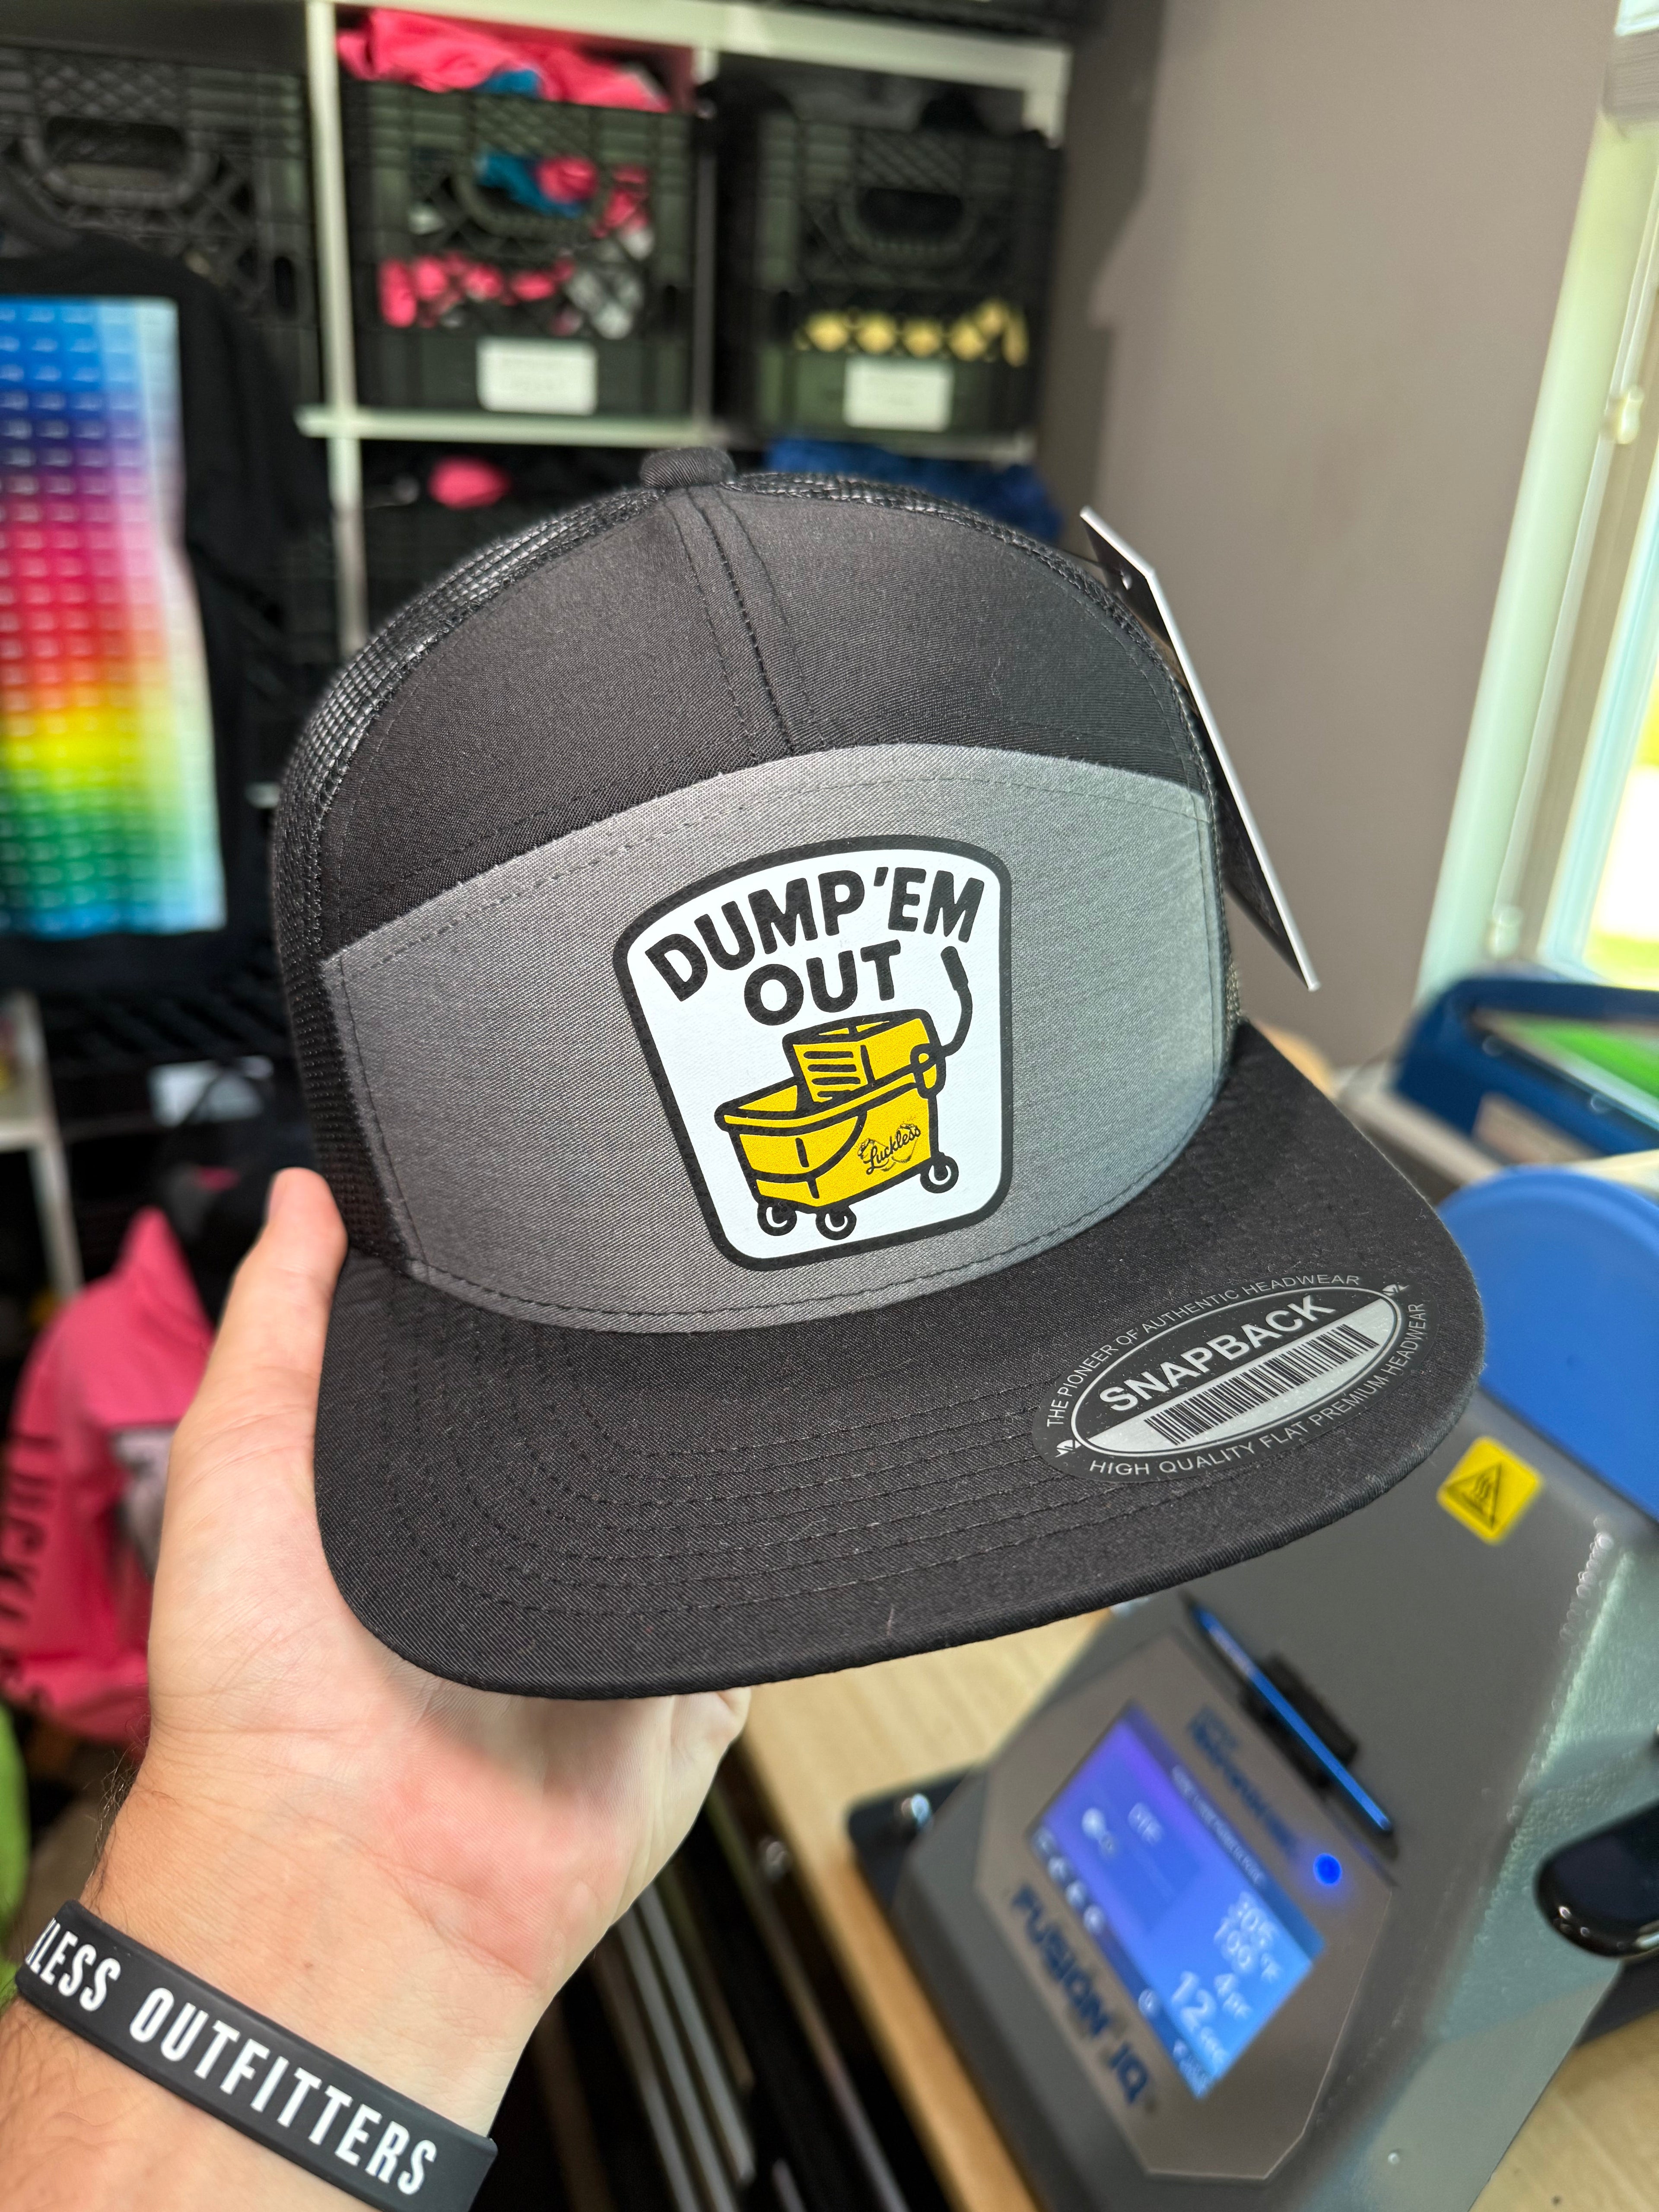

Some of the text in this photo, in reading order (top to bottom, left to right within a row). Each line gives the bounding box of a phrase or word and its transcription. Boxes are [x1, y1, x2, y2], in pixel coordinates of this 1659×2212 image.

[744, 940, 901, 1026] OUT
[863, 1128, 921, 1175] Luckless
[1047, 1275, 1359, 1427] THE PIONEER OF AUTHENTIC HEADWEAR
[1090, 1304, 1426, 1475] HIGH QUALITY FLAT PREMIUM HEADWEAR
[1100, 1295, 1335, 1411] SNAPBACK
[1012, 1885, 1109, 2036] FUSION
[1172, 1971, 1216, 2032] 12
[26, 1918, 436, 2194] LESS OUTFITTERS
